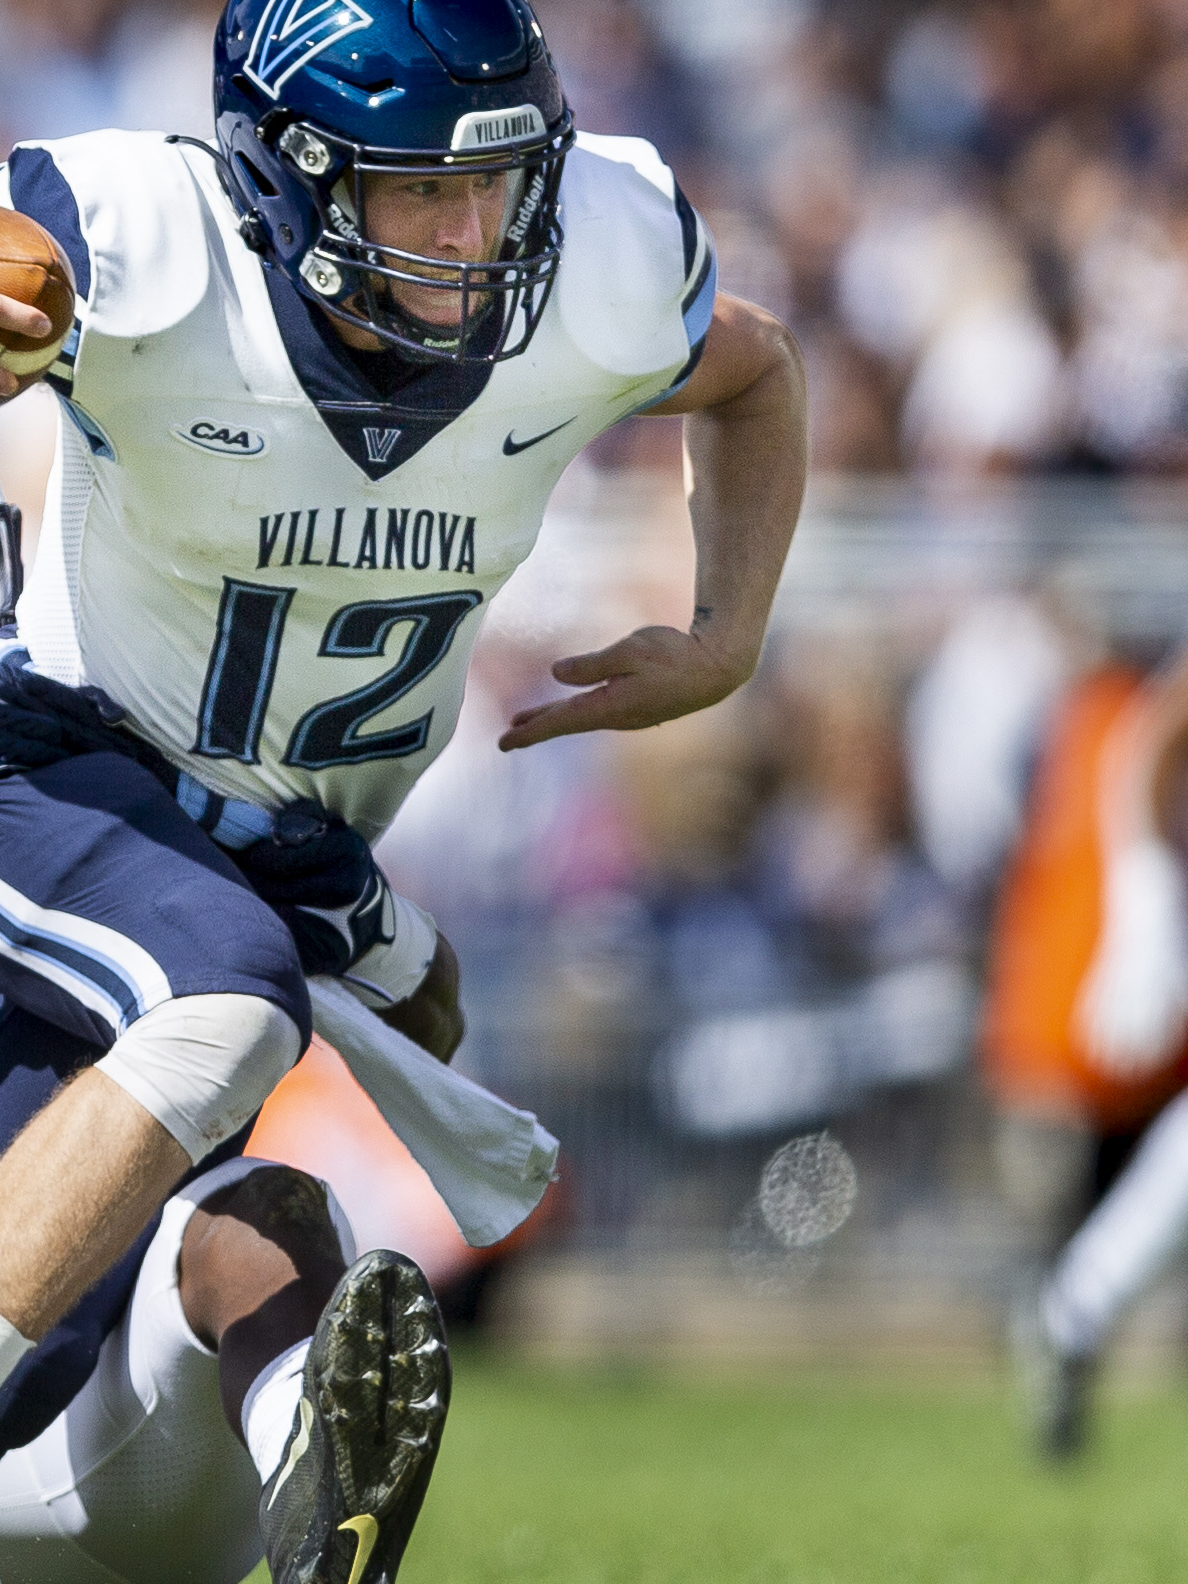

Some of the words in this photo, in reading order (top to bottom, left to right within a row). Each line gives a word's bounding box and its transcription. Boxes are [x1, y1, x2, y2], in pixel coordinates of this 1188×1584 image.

[475, 113, 536, 144] VILLANOVA
[506, 174, 544, 243] Riddell
[190, 422, 250, 448] CAA
[363, 427, 401, 463] V
[256, 506, 477, 575] VILLANOVA
[188, 575, 484, 771] 12
